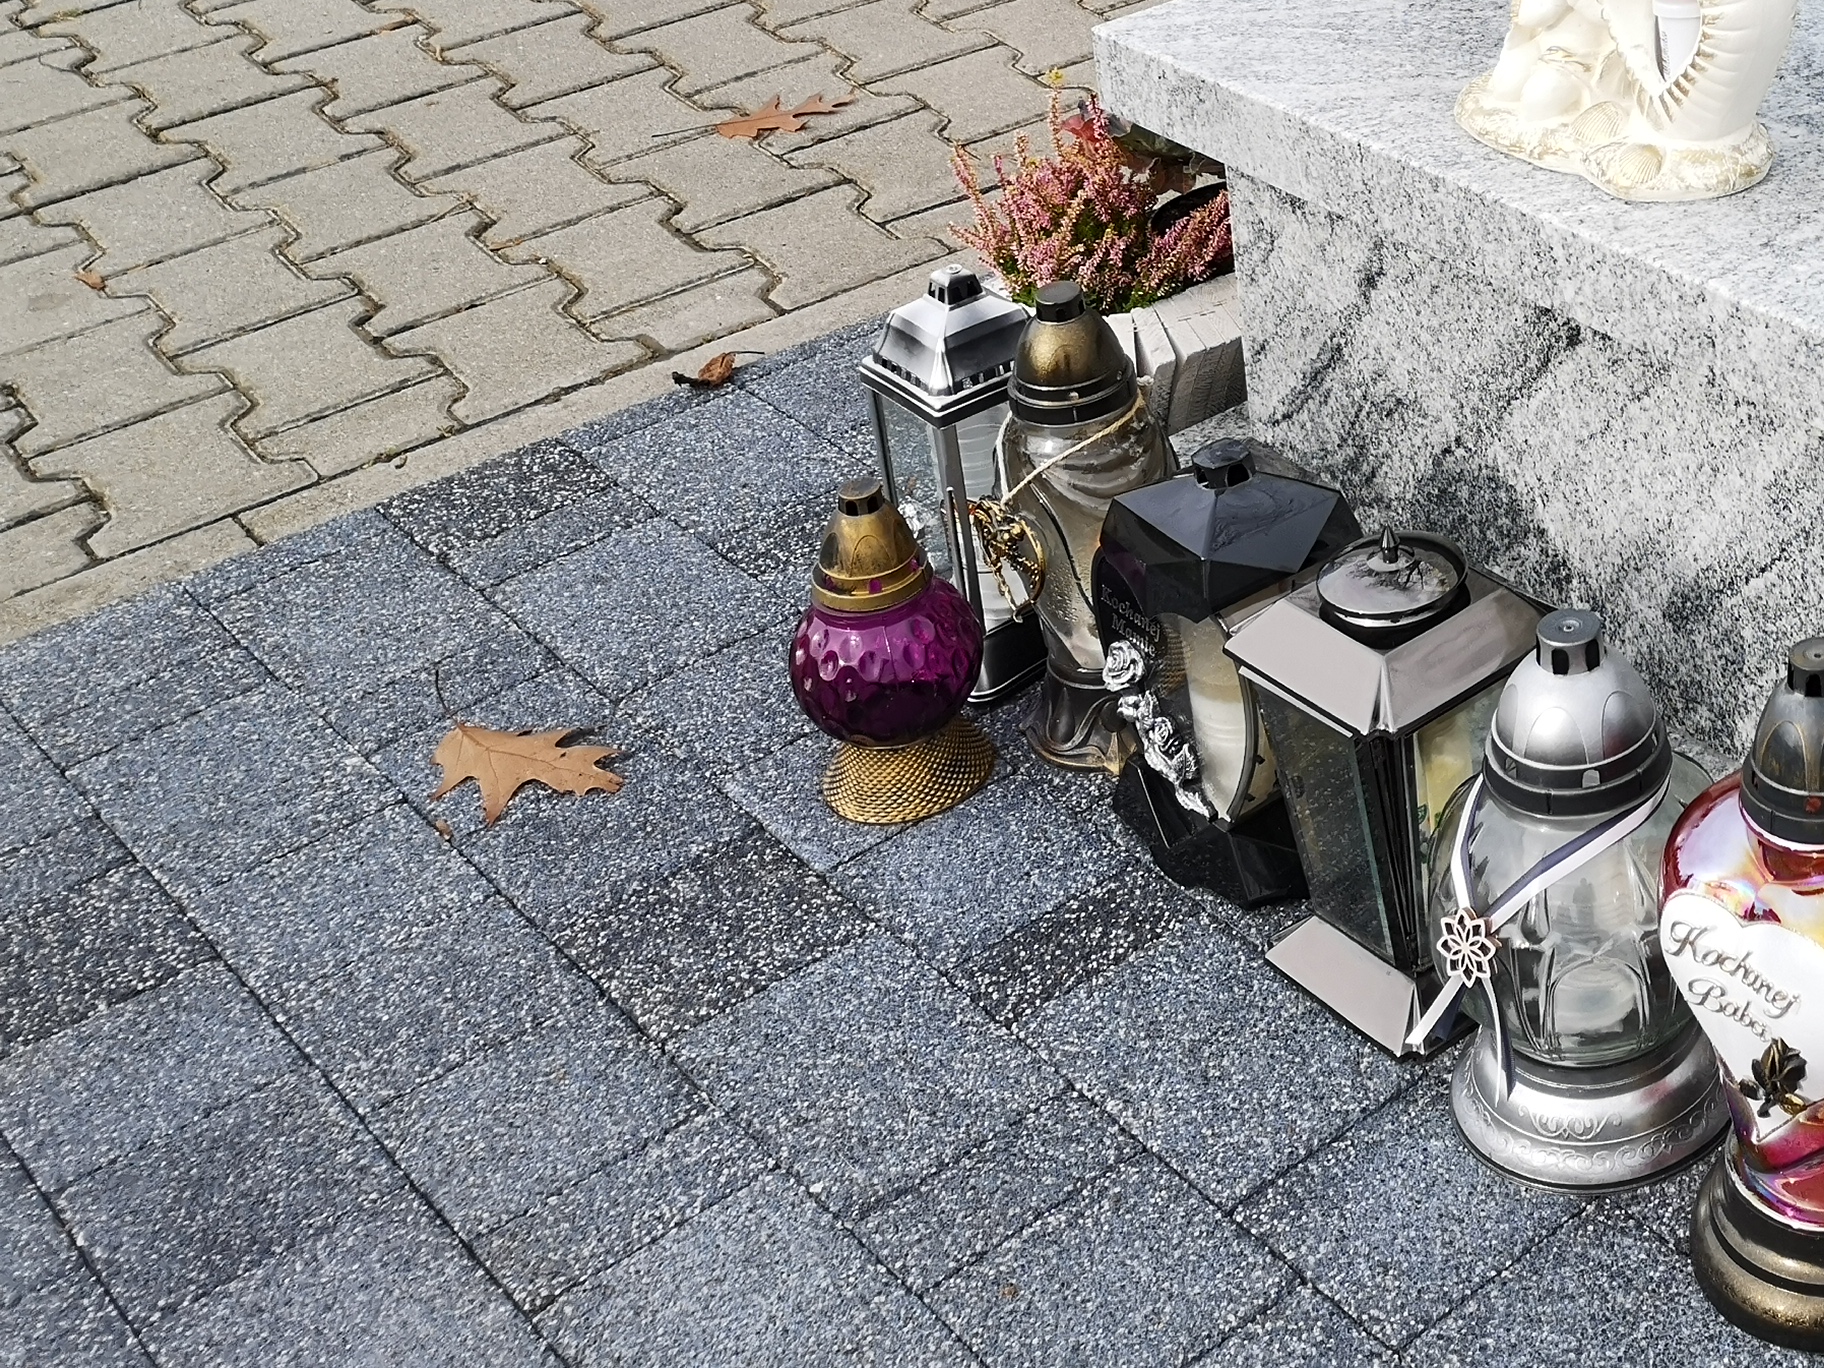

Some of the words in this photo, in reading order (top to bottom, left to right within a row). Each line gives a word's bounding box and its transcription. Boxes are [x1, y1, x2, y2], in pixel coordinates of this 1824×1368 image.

[1101, 584, 1161, 643] Kochanej
[1111, 613, 1156, 657] Mamie
[1664, 920, 1802, 1019] Kochanej
[1685, 978, 1772, 1043] Babci
